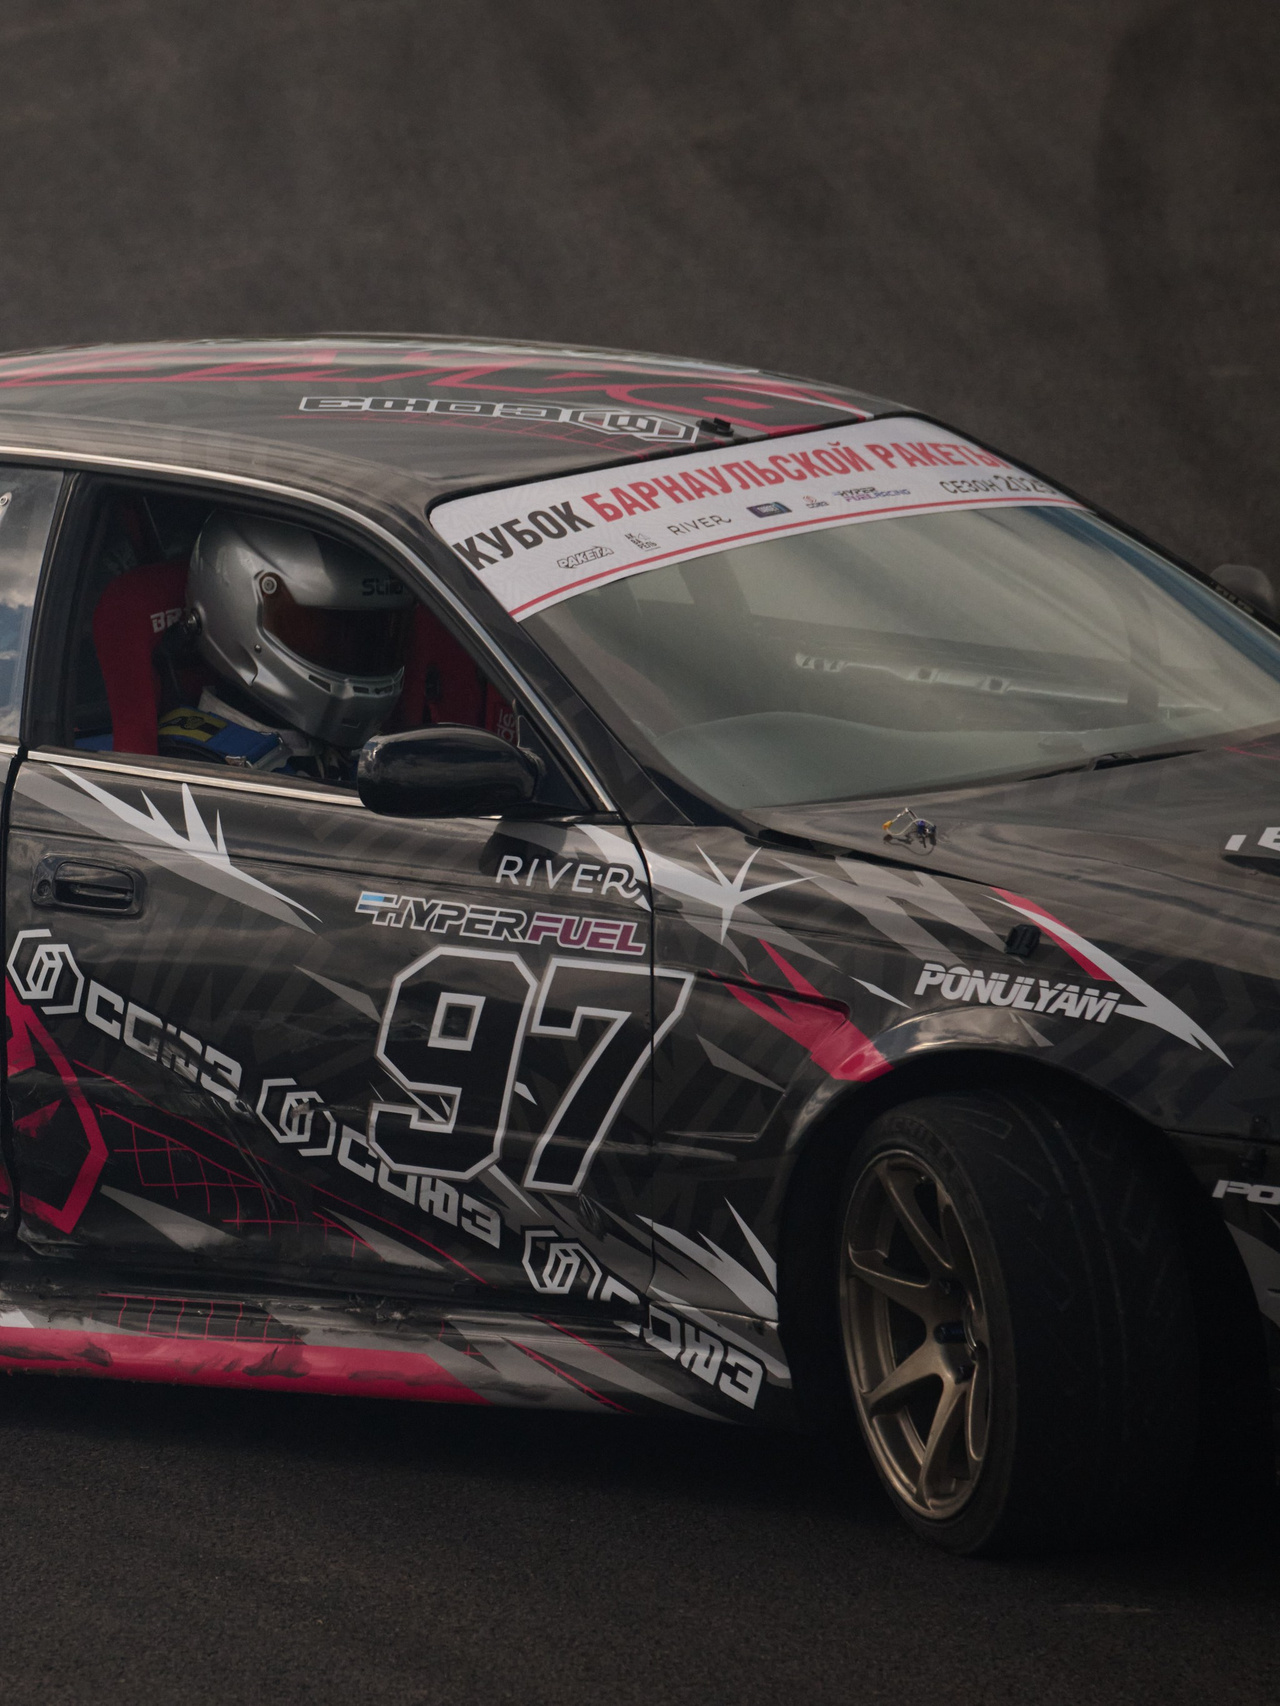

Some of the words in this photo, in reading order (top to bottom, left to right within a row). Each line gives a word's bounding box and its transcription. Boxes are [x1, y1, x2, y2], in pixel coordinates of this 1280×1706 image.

[453, 501, 595, 571] КУБОК
[581, 442, 875, 523] БАРНАУЛЬСКОЙ
[939, 479, 1002, 494] СЕЗОН
[667, 514, 732, 536] RIVER
[556, 545, 615, 569] РАКЕТА
[496, 855, 641, 899] RIVER
[915, 963, 1120, 1024] PONULYAM
[368, 945, 696, 1196] 97
